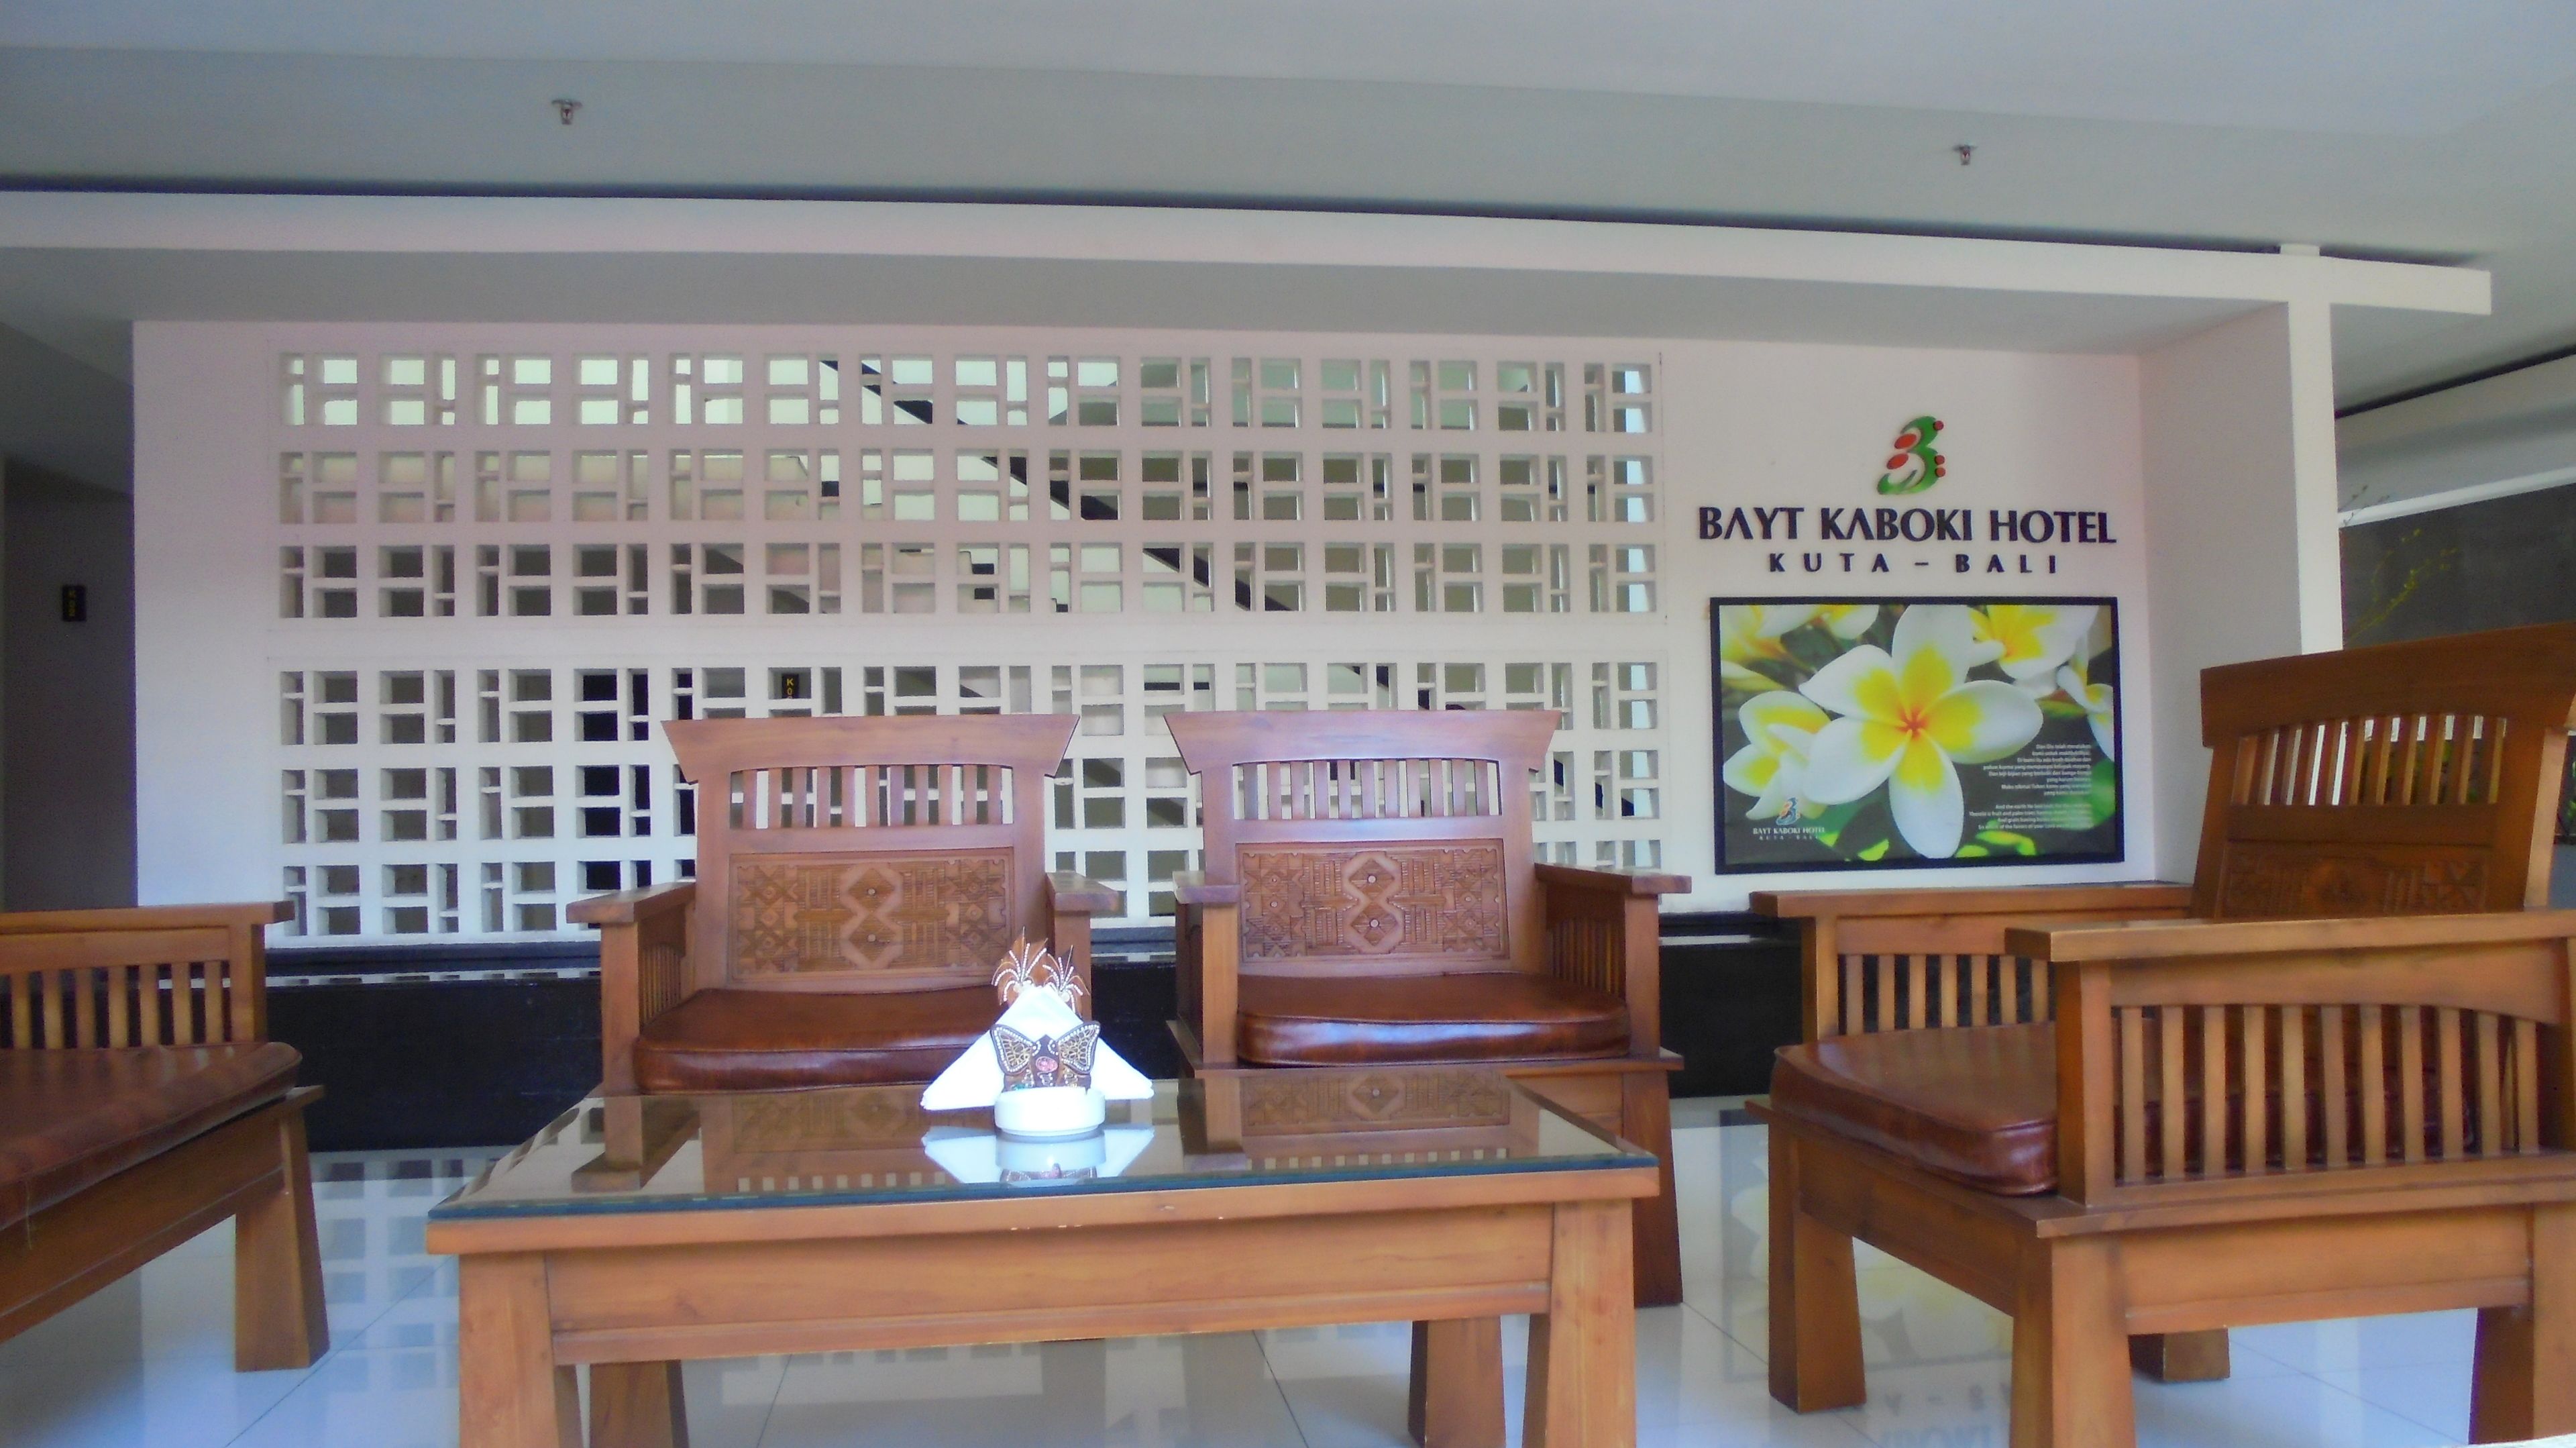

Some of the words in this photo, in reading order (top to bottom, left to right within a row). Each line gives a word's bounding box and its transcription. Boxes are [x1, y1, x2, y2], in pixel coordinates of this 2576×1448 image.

[1699, 507, 1805, 540] BAYT
[1820, 507, 1973, 542] KABOKI
[1989, 509, 2117, 544] HOTEL
[1769, 552, 1890, 573] KUTA
[1955, 554, 2057, 574] BALI
